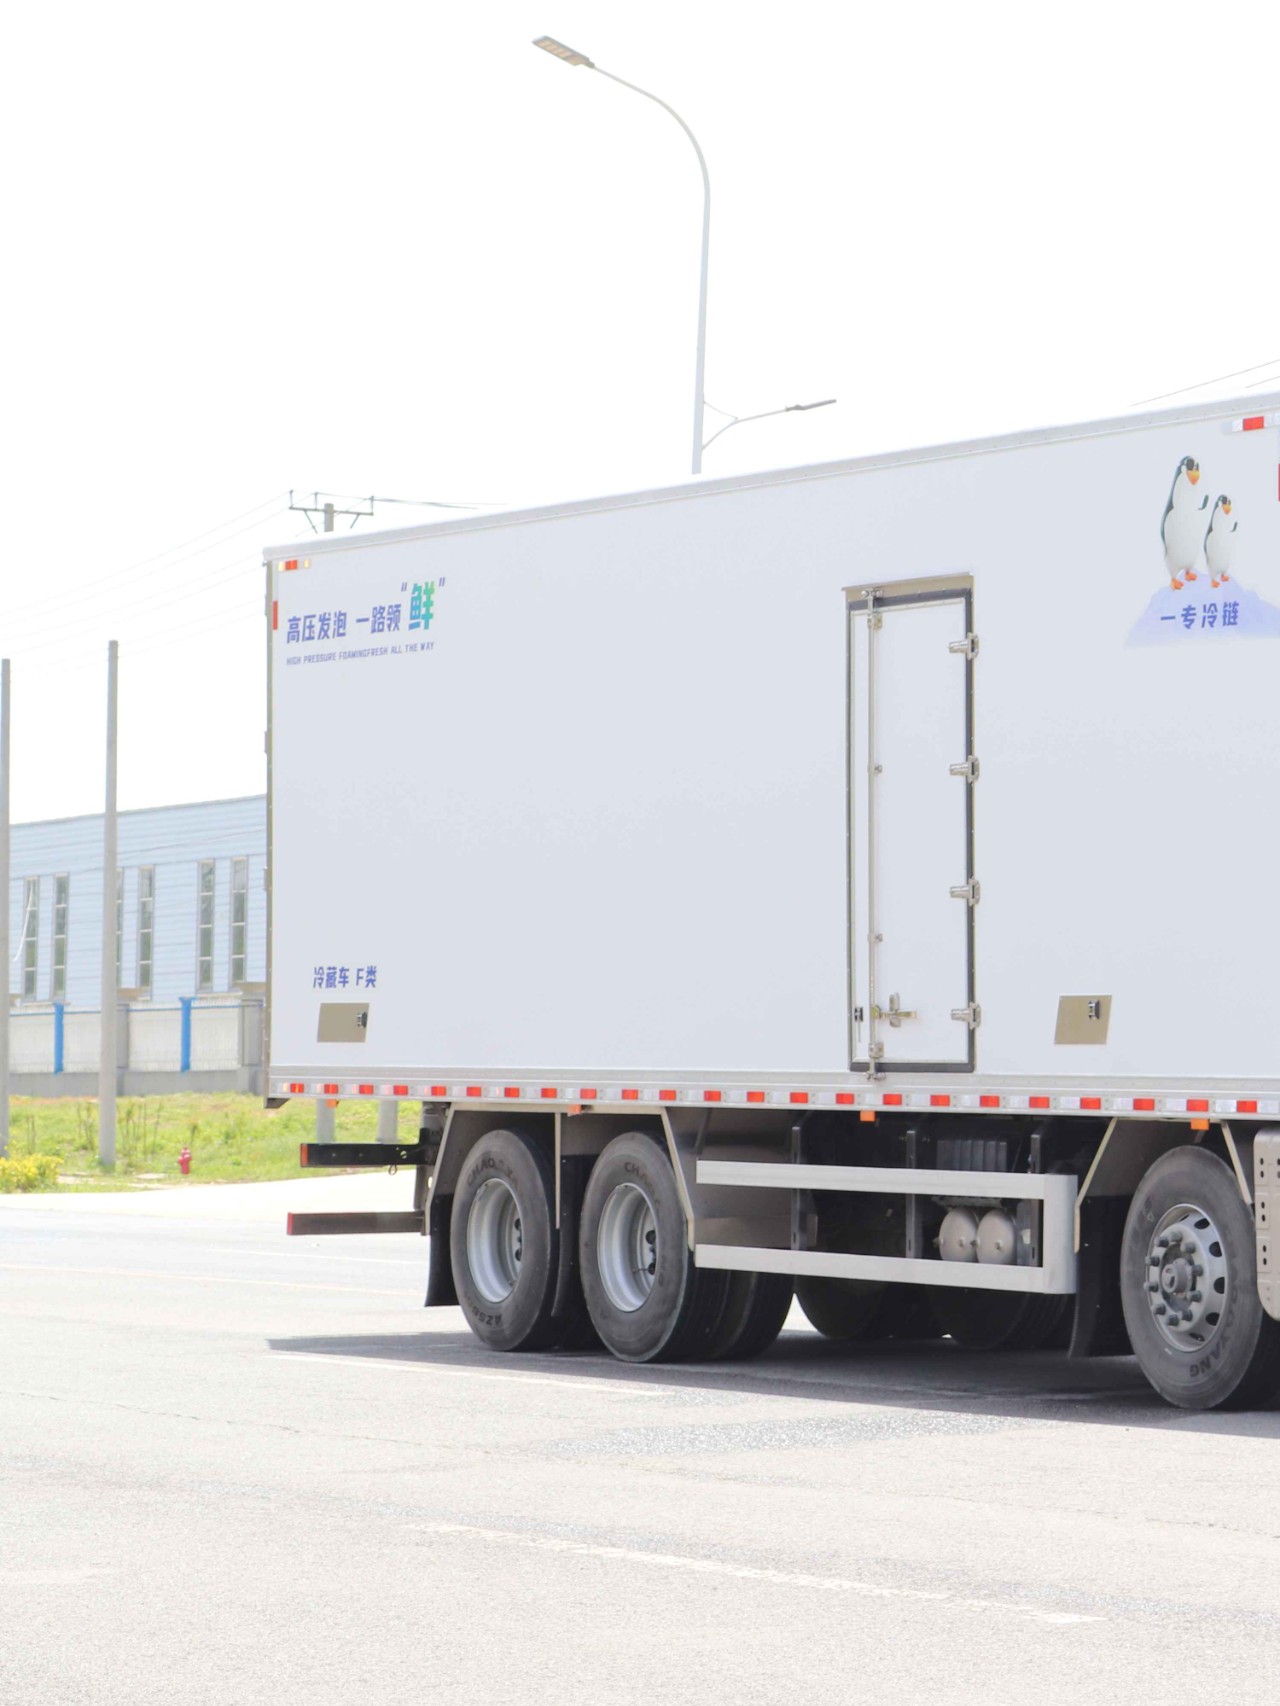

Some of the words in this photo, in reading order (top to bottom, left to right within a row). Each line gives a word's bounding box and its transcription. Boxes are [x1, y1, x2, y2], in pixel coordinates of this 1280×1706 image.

[286, 610, 347, 644] 高压发泡
[1160, 600, 1240, 630] 一专冷链
[286, 656, 301, 665] HIGH
[303, 652, 336, 664] PRESSURE
[390, 645, 402, 654] ALL
[405, 643, 418, 652] THE
[420, 641, 435, 651] WAY
[313, 966, 350, 988] 冷藏车
[356, 965, 377, 988] F类
